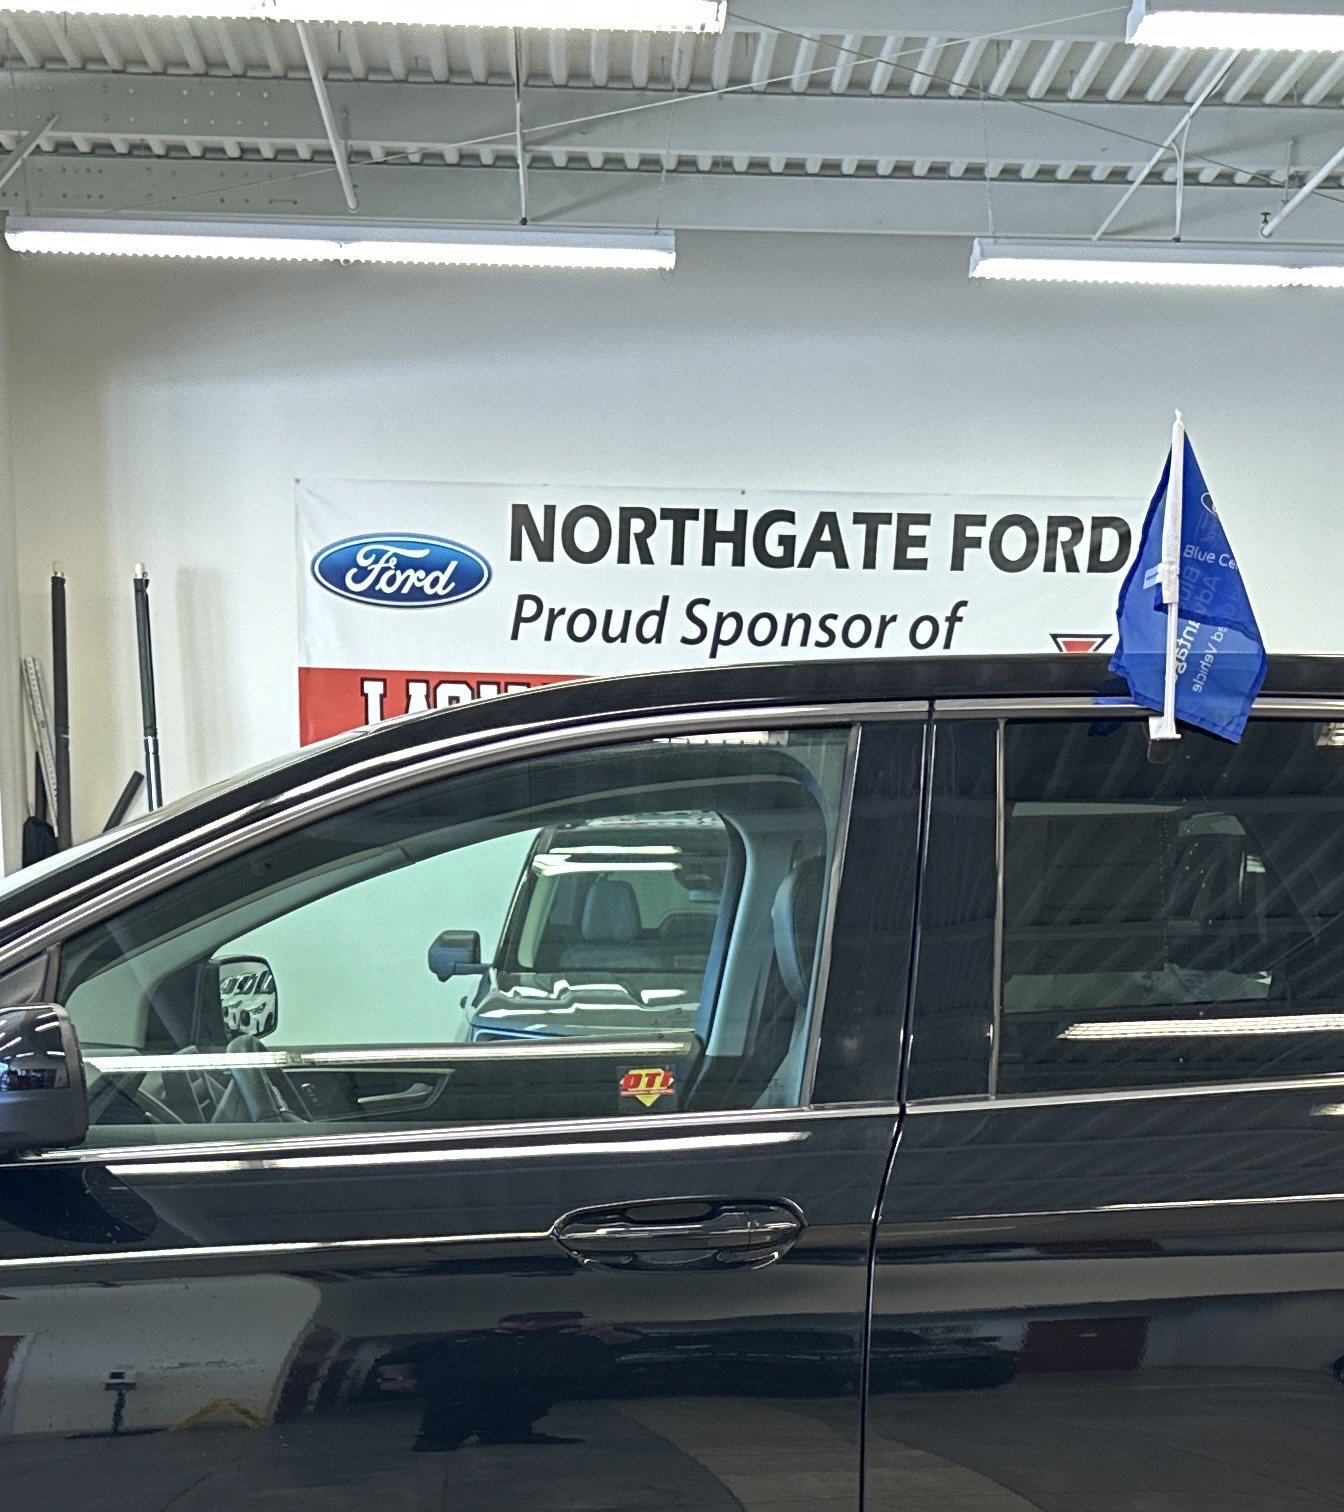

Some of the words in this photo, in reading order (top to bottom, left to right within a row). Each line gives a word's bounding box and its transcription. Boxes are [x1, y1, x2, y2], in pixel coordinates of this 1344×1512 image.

[509, 503, 932, 571] NORTHGATE
[950, 513, 1133, 574] FORD
[1182, 543, 1216, 564] Blue
[510, 593, 689, 646] Proud
[679, 597, 894, 659] Sponsor
[908, 600, 969, 650] of
